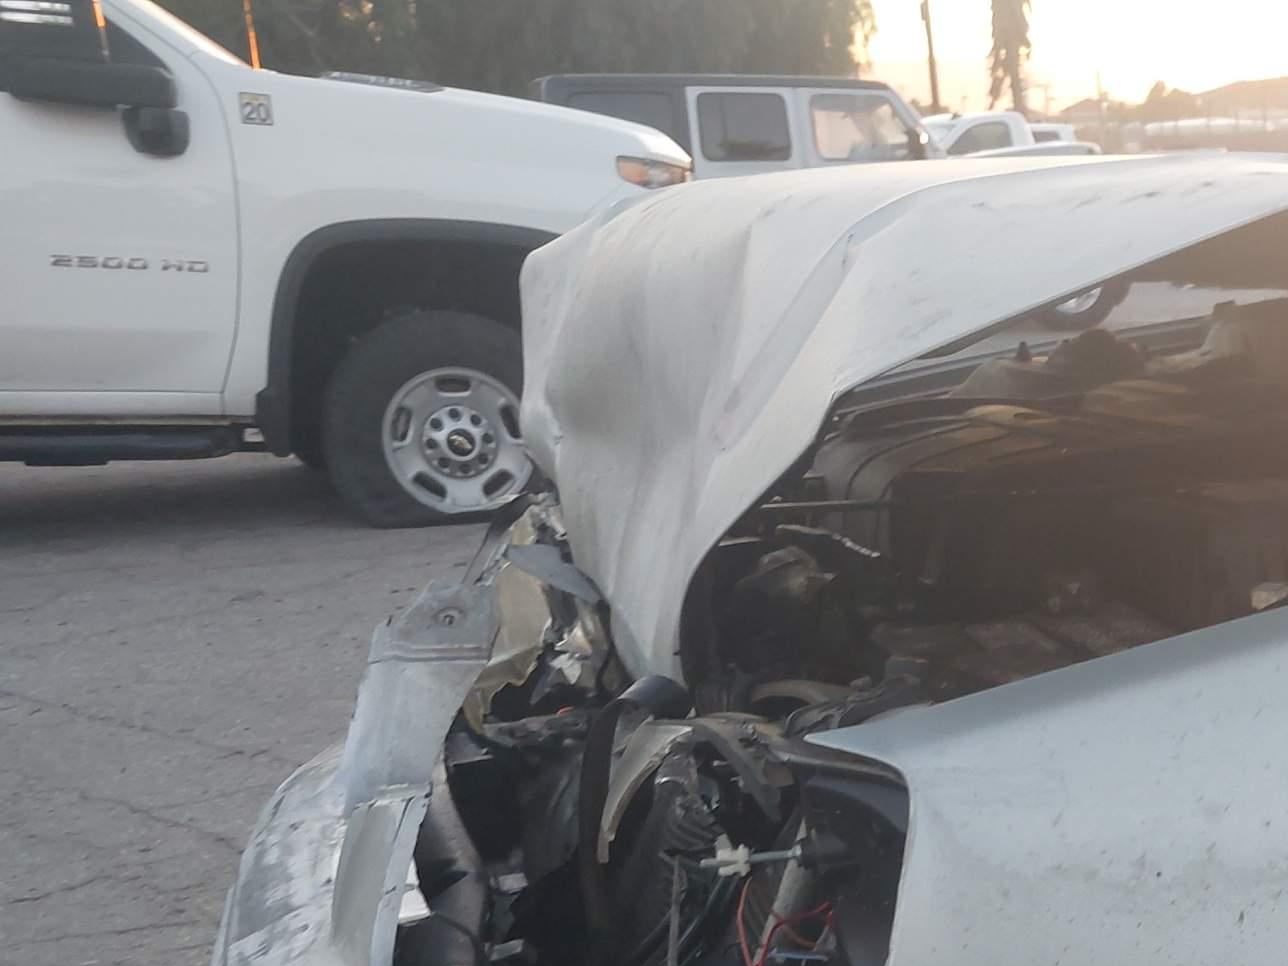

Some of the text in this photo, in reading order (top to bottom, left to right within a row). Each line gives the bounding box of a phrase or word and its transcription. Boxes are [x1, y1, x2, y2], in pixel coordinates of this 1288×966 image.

[241, 101, 271, 123] 20
[50, 253, 210, 274] 2500 HD
